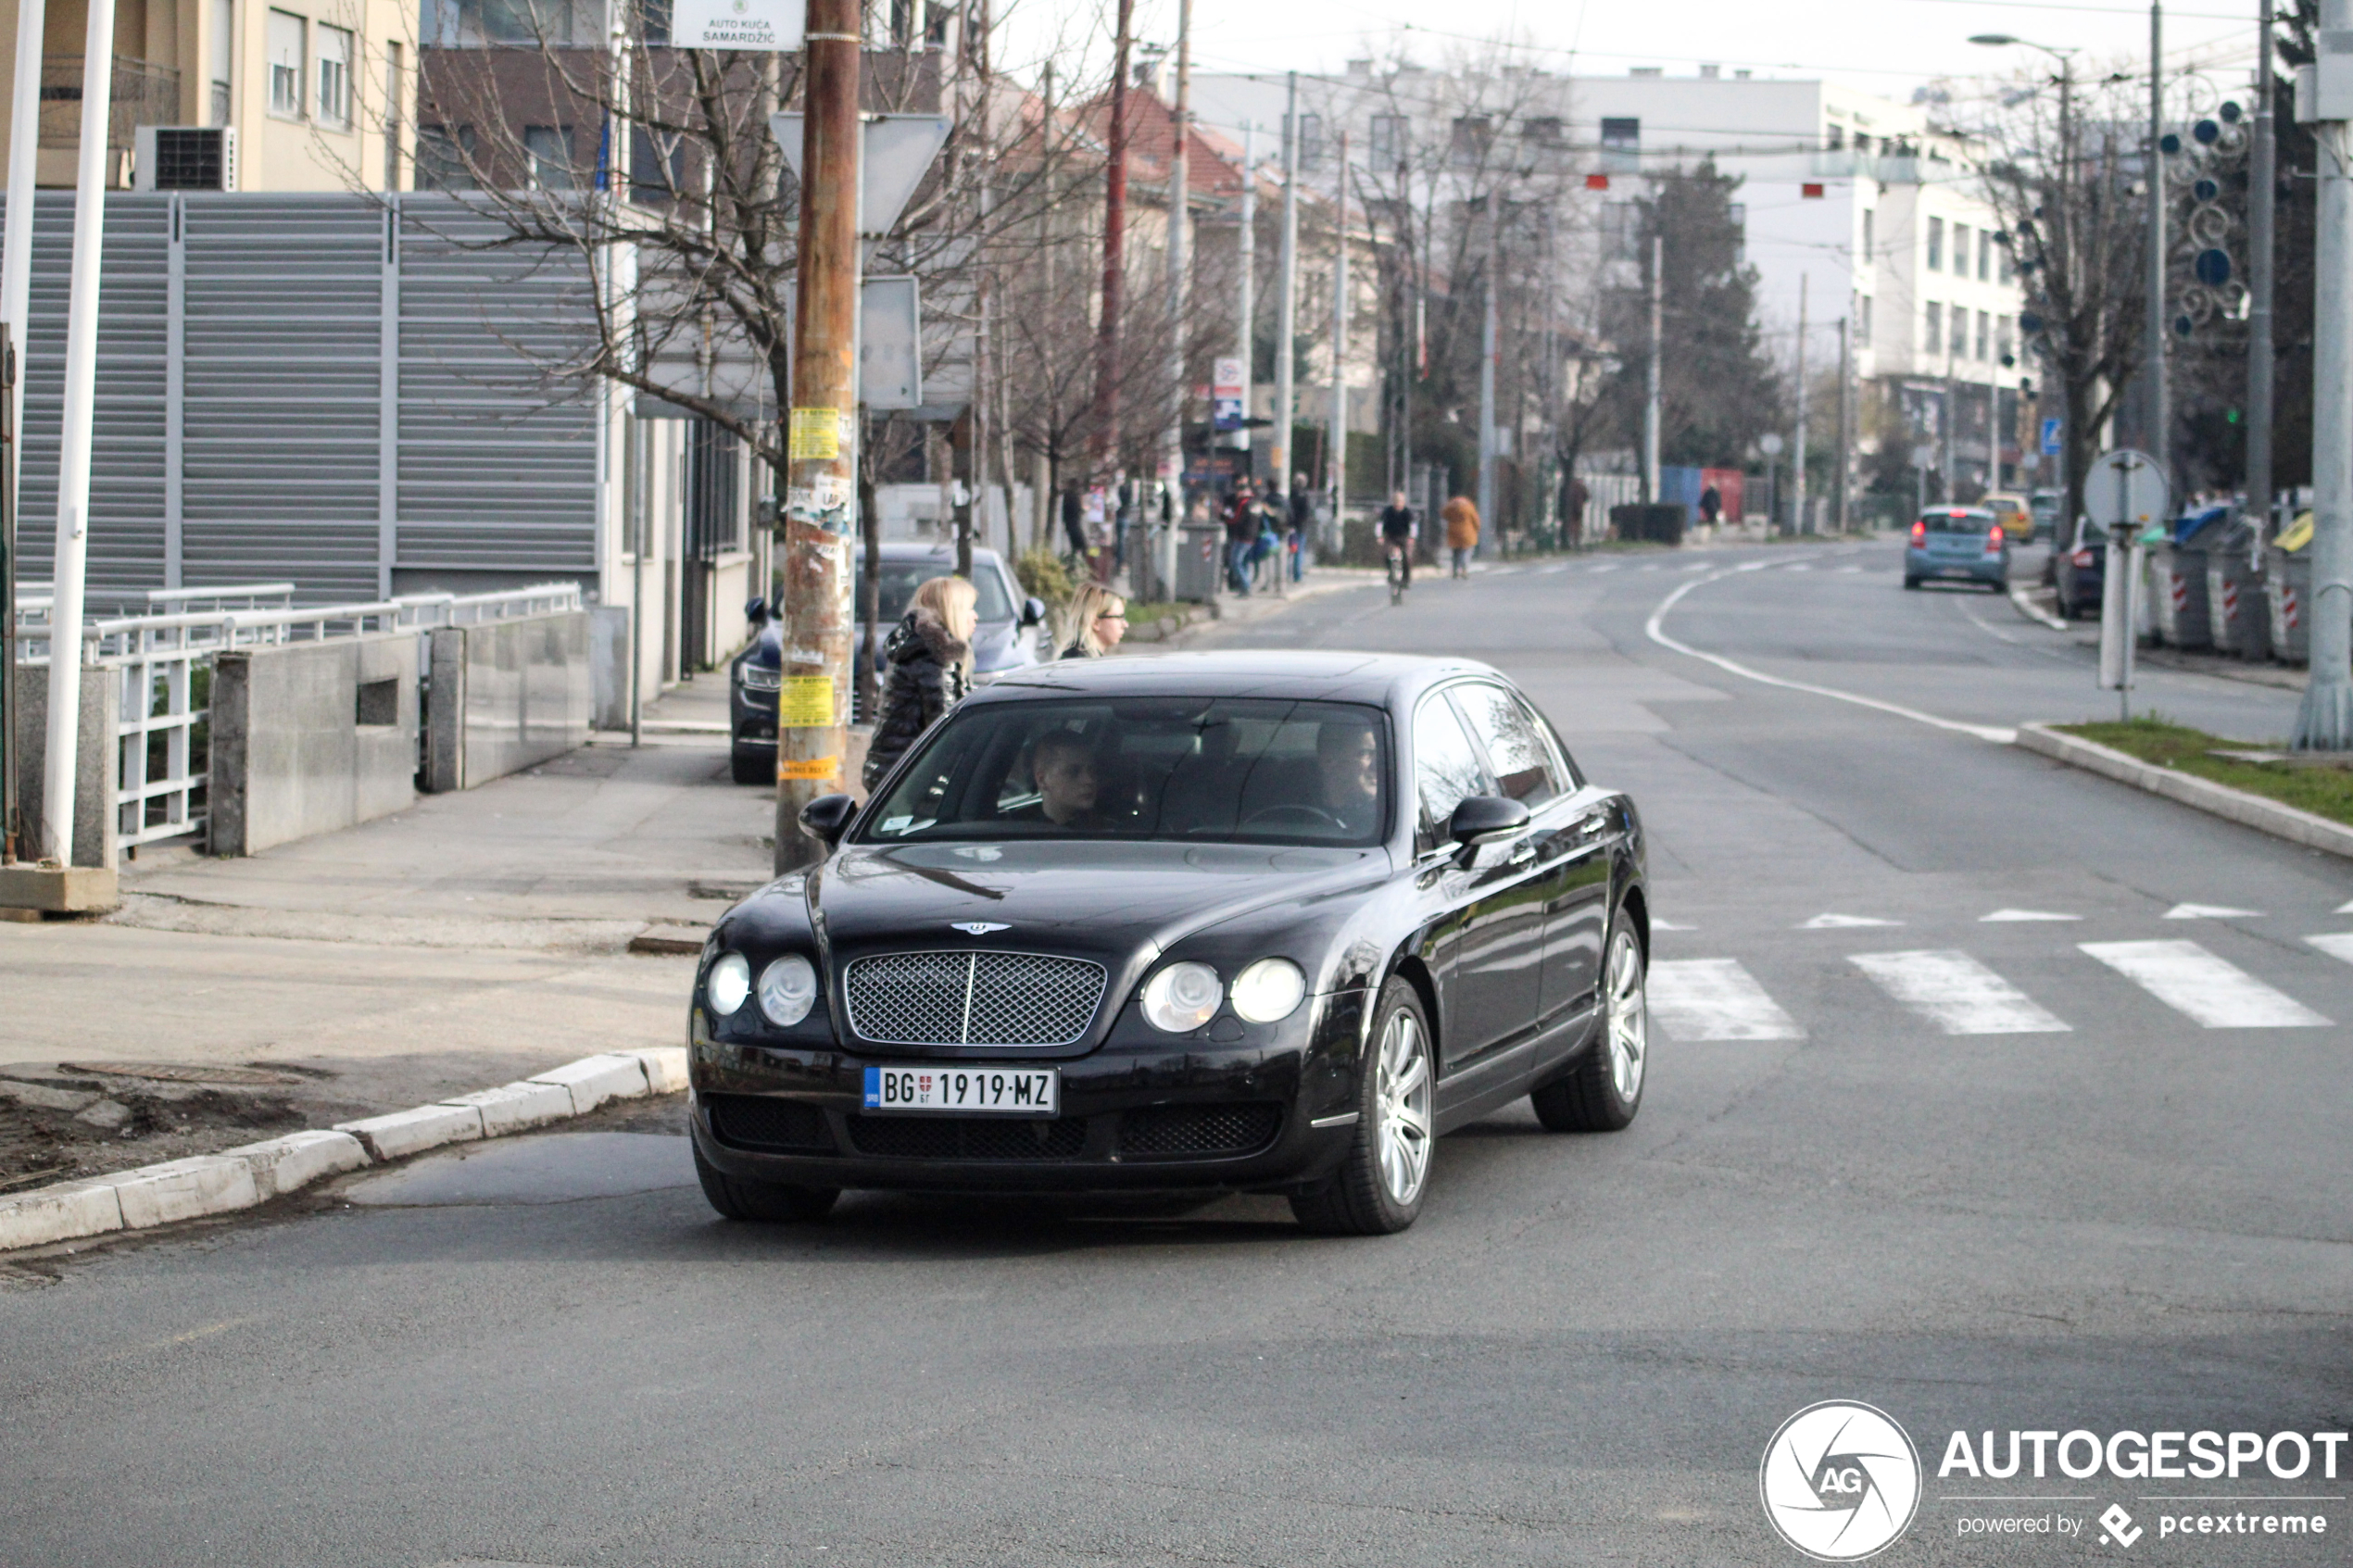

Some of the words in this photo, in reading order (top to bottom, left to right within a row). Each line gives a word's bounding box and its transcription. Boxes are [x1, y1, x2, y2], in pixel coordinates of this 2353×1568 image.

[709, 19, 738, 30] AUTO
[741, 18, 771, 31] KUĆA
[702, 31, 775, 44] SAMARDŽIĆ
[885, 1073, 914, 1102] BG
